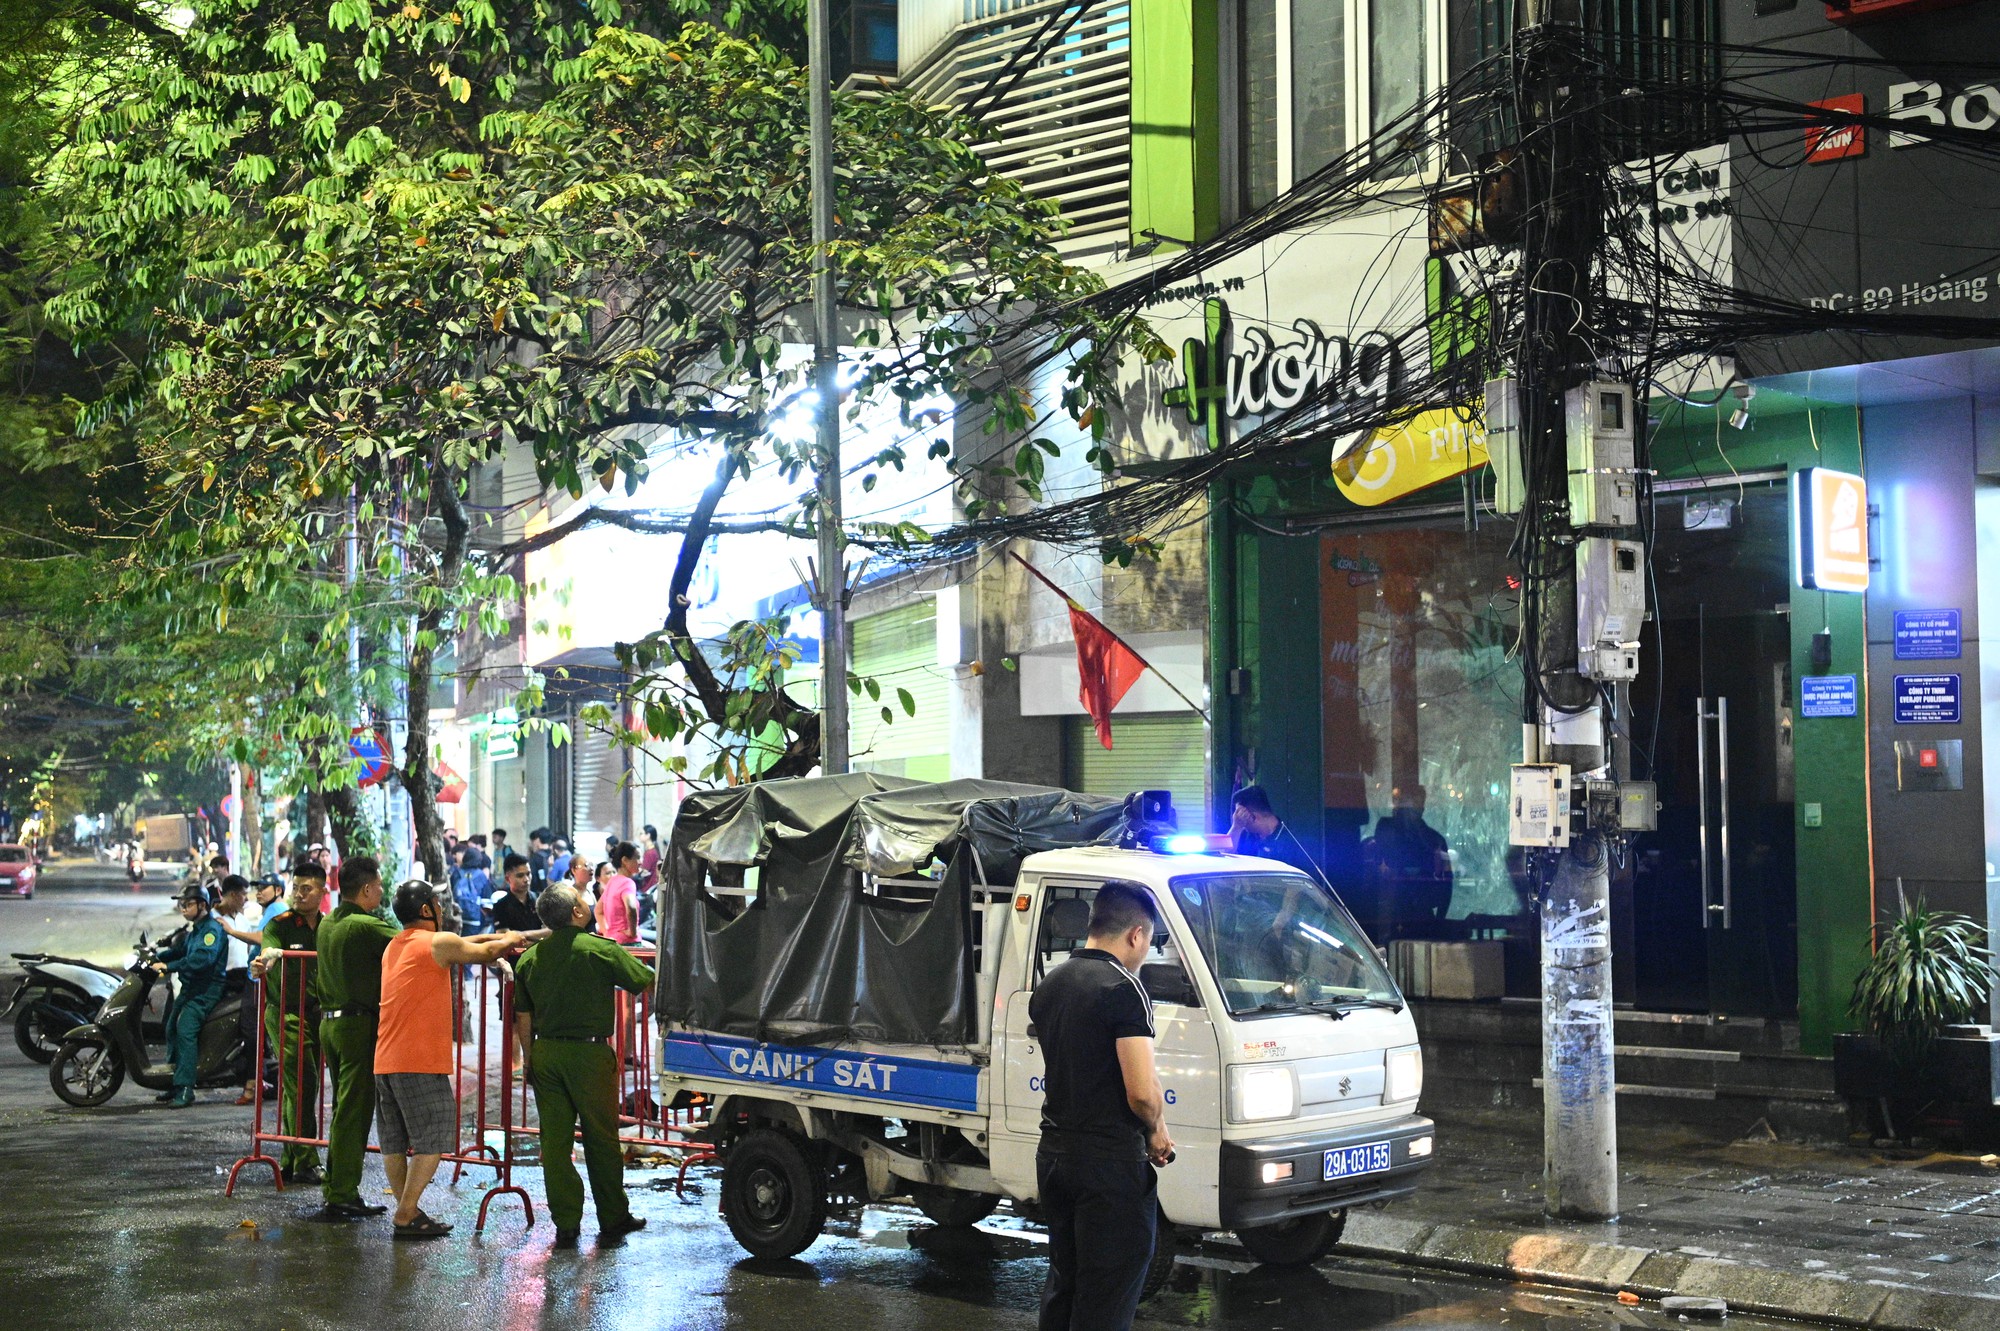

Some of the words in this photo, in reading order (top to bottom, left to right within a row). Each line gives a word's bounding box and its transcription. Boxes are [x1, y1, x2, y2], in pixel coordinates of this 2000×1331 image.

[1863, 286, 1893, 311] 89
[1901, 273, 1988, 303] Hoàng
[729, 1042, 814, 1083] CẢNH
[833, 1056, 898, 1091] SÁT
[1326, 1144, 1389, 1177] 29A-031.55
